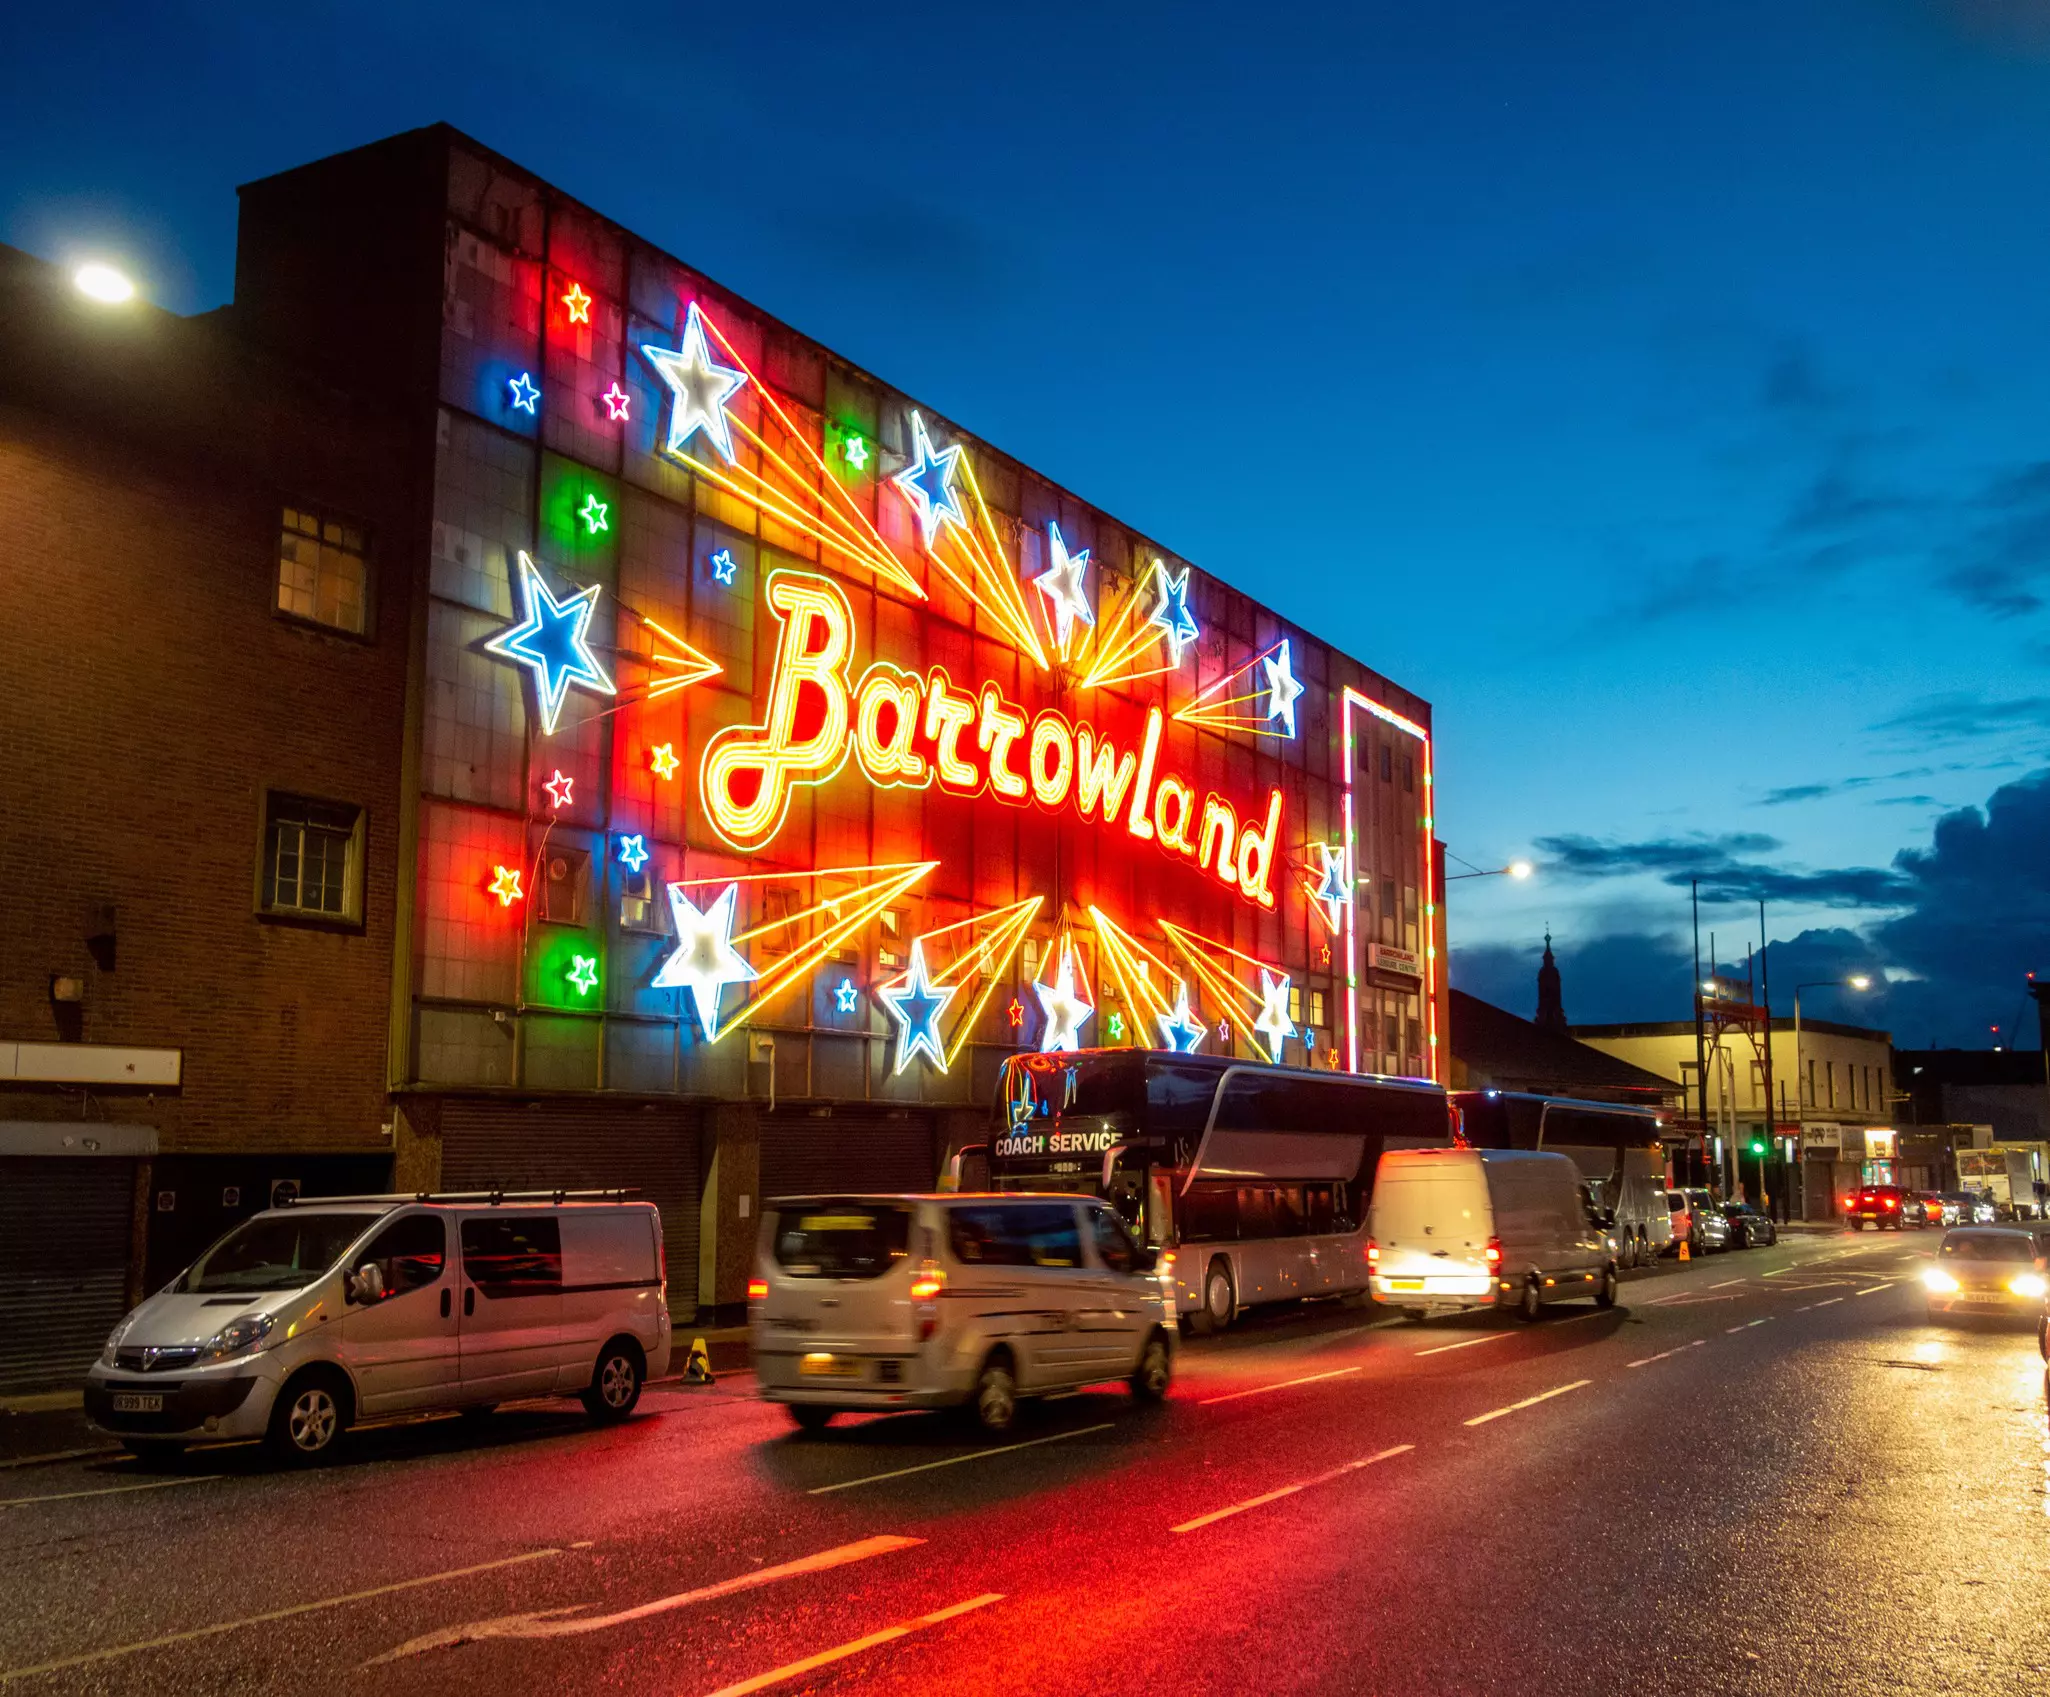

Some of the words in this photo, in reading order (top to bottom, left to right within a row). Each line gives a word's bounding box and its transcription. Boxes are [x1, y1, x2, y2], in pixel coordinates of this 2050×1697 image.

[701, 568, 1283, 911] Barrowland
[995, 1136, 1043, 1155] COACH
[1049, 1132, 1123, 1152] SERVICE
